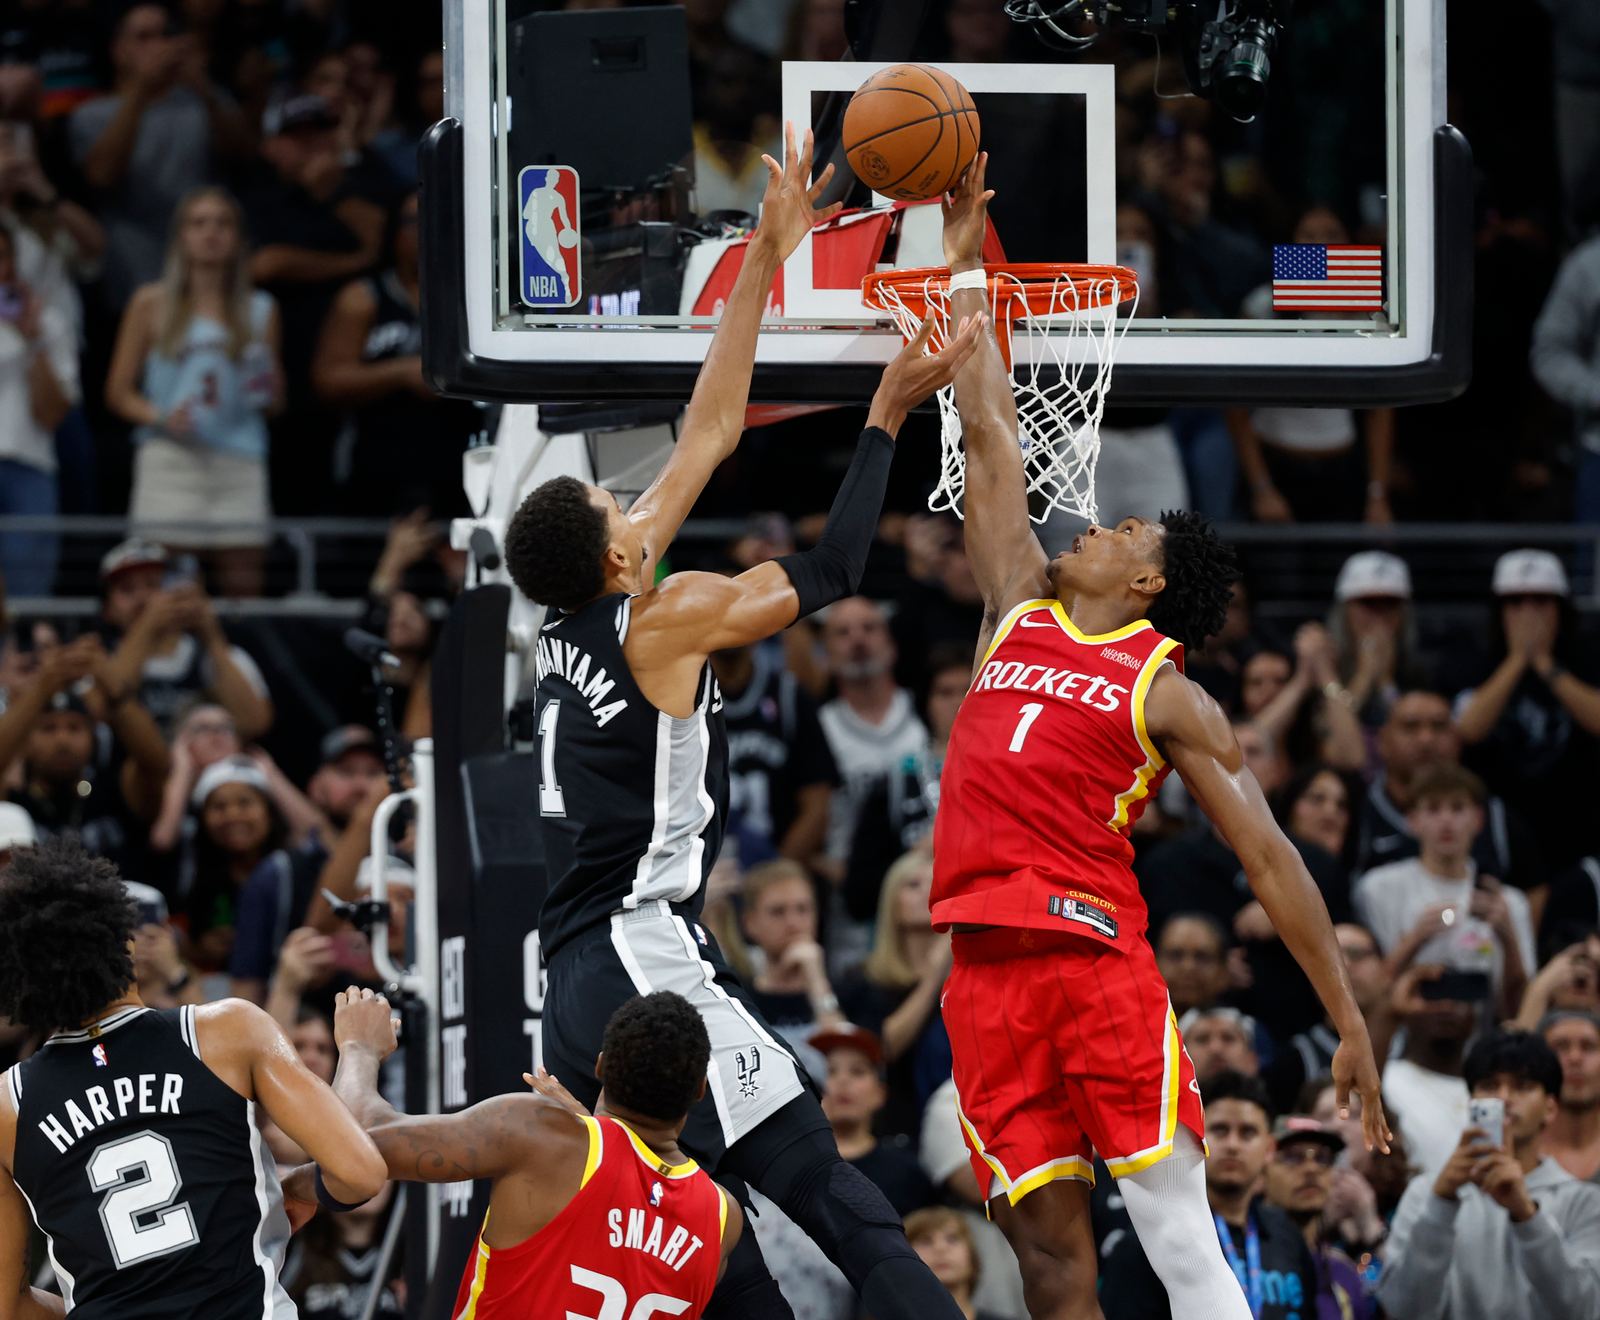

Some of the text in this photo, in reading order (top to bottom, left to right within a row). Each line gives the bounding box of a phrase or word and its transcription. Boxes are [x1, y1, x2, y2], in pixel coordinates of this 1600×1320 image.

[529, 276, 559, 298] NBA
[538, 698, 567, 818] 1
[1008, 702, 1044, 753] 1
[1069, 890, 1118, 913] CLUTCH CITY
[38, 1073, 184, 1154] HARPER
[85, 1128, 201, 1271] 2
[608, 1207, 704, 1272] SMART
